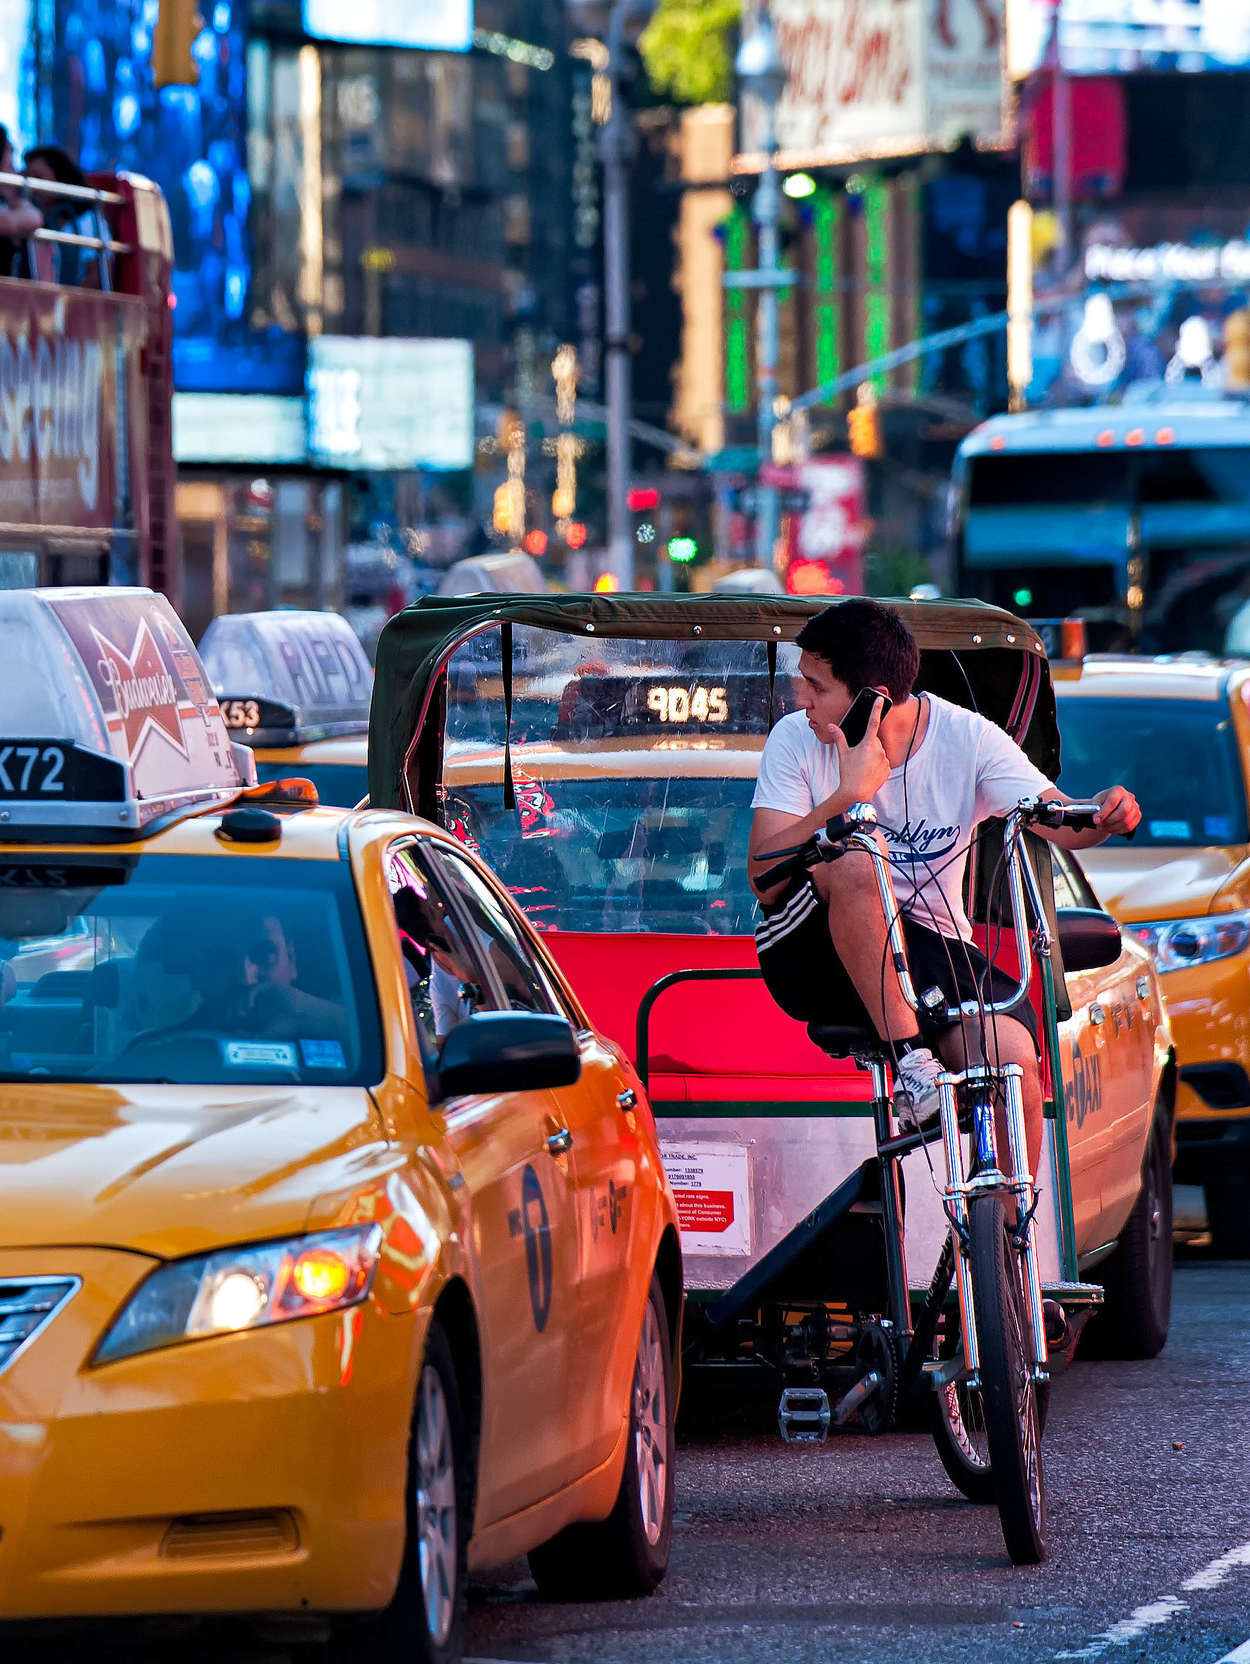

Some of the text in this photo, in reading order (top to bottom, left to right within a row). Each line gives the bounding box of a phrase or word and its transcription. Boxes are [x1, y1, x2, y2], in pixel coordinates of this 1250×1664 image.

[97, 657, 177, 719] Budweiser
[647, 687, 728, 722] 9045
[883, 819, 960, 852] oklyn
